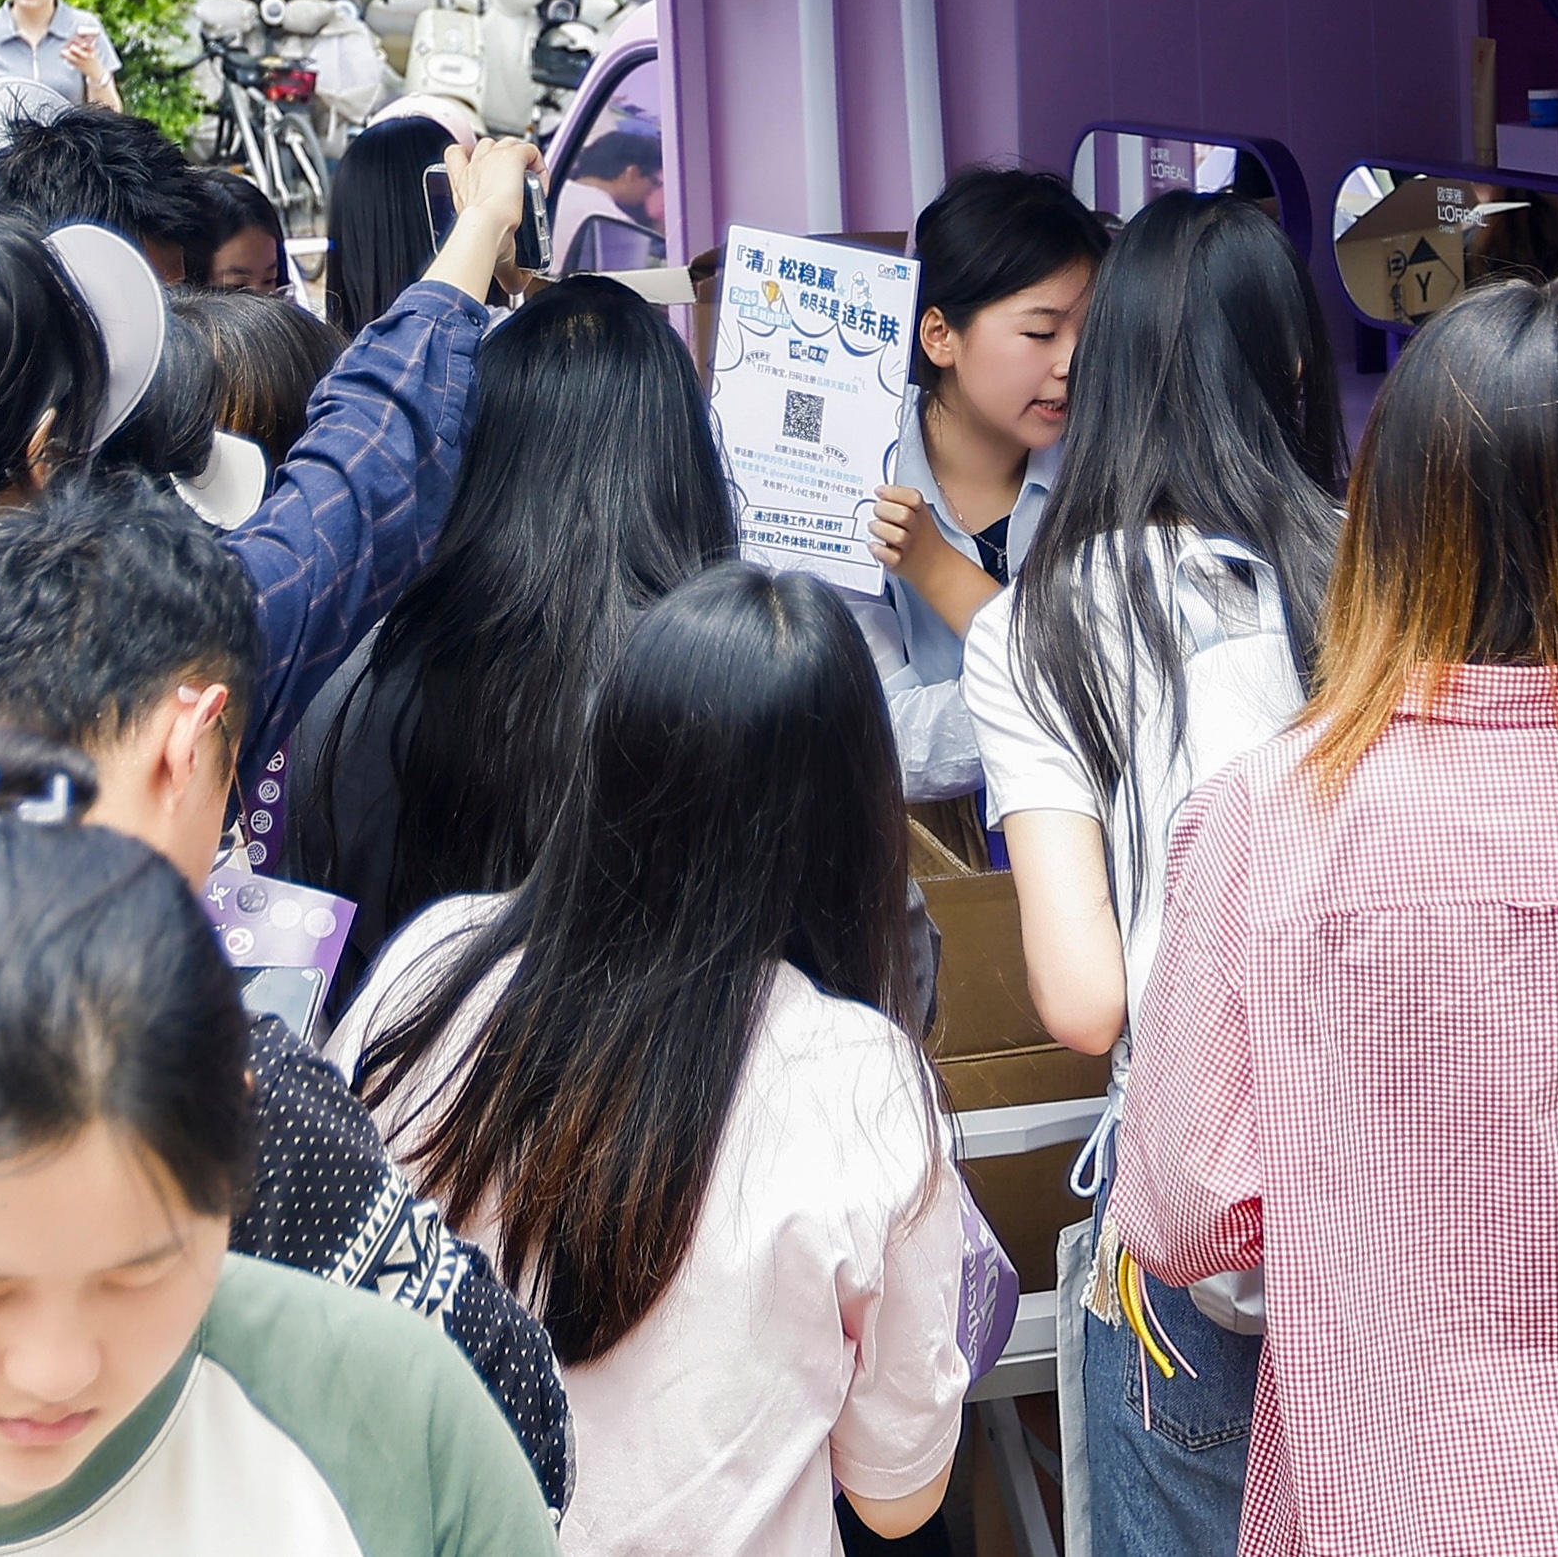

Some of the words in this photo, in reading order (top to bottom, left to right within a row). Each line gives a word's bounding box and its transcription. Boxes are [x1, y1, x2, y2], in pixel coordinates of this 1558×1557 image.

[753, 510, 843, 533] 通过现场工作人员核对
